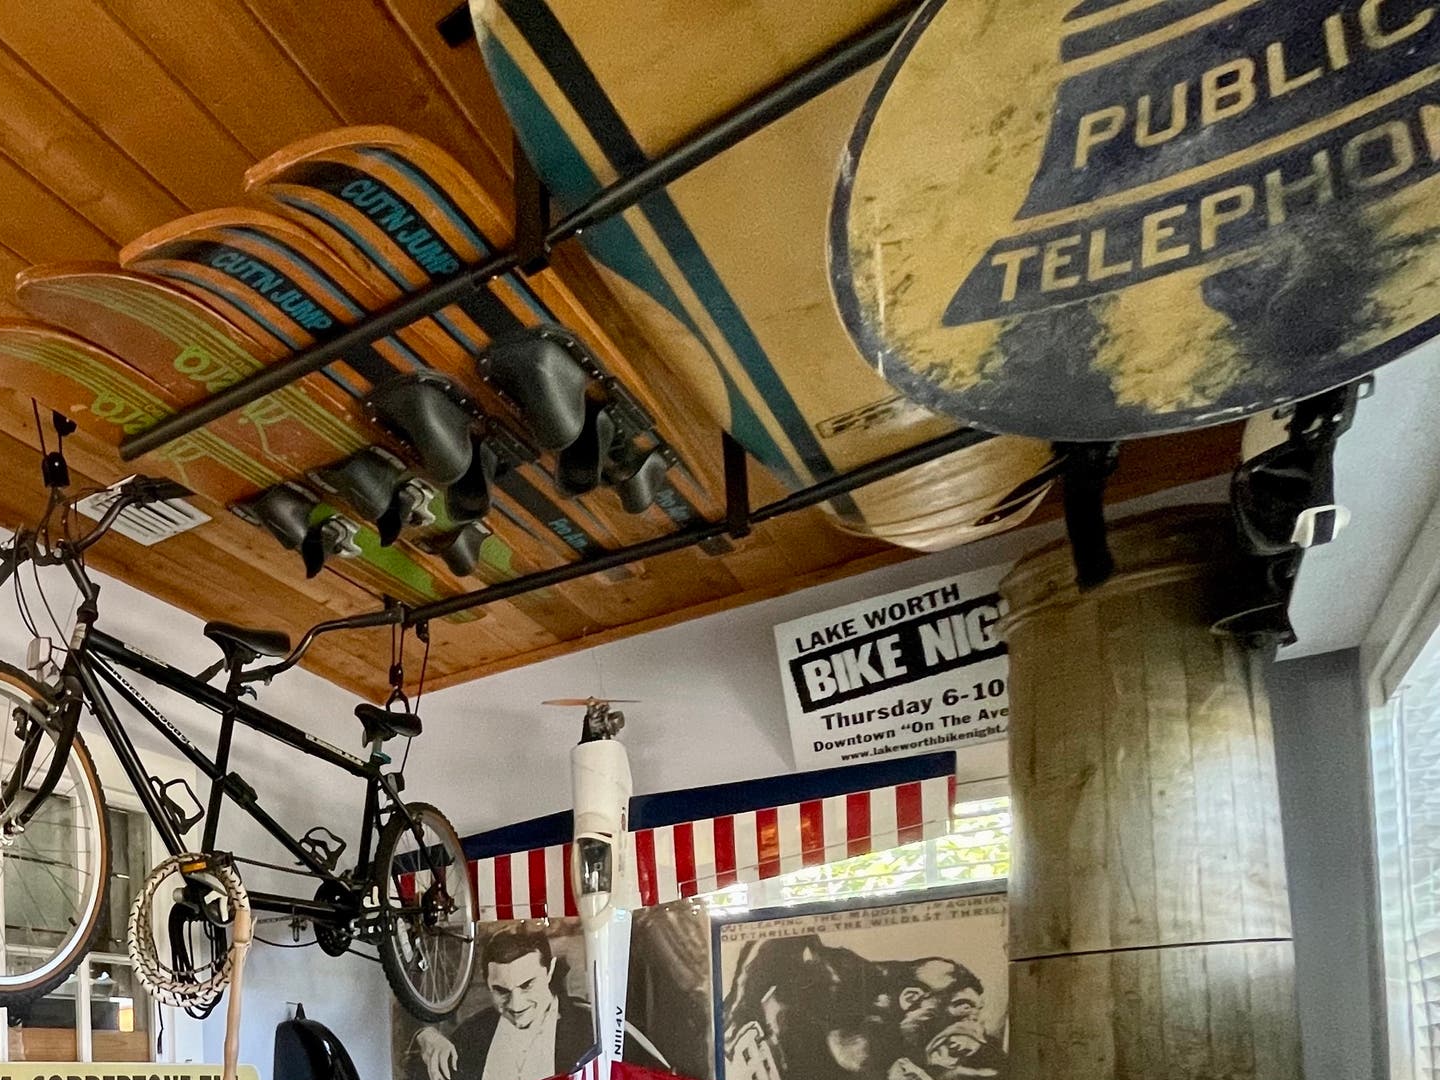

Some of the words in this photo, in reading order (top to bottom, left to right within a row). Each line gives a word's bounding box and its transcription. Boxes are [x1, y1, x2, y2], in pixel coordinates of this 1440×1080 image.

[1073, 0, 1436, 171] PUBLIC
[398, 227, 461, 275] JUMP
[270, 290, 334, 330] JUMP
[795, 618, 858, 654] LAKE
[863, 582, 961, 631] WORTH
[801, 633, 908, 704] BIKE
[821, 695, 933, 732] Thursday
[942, 677, 1005, 708] 6-10
[813, 728, 896, 754] Downtown
[940, 713, 972, 730] The
[978, 706, 1009, 722] Ave
[840, 724, 1009, 763] www.lakeworthbikenight.
[835, 920, 863, 931] THE
